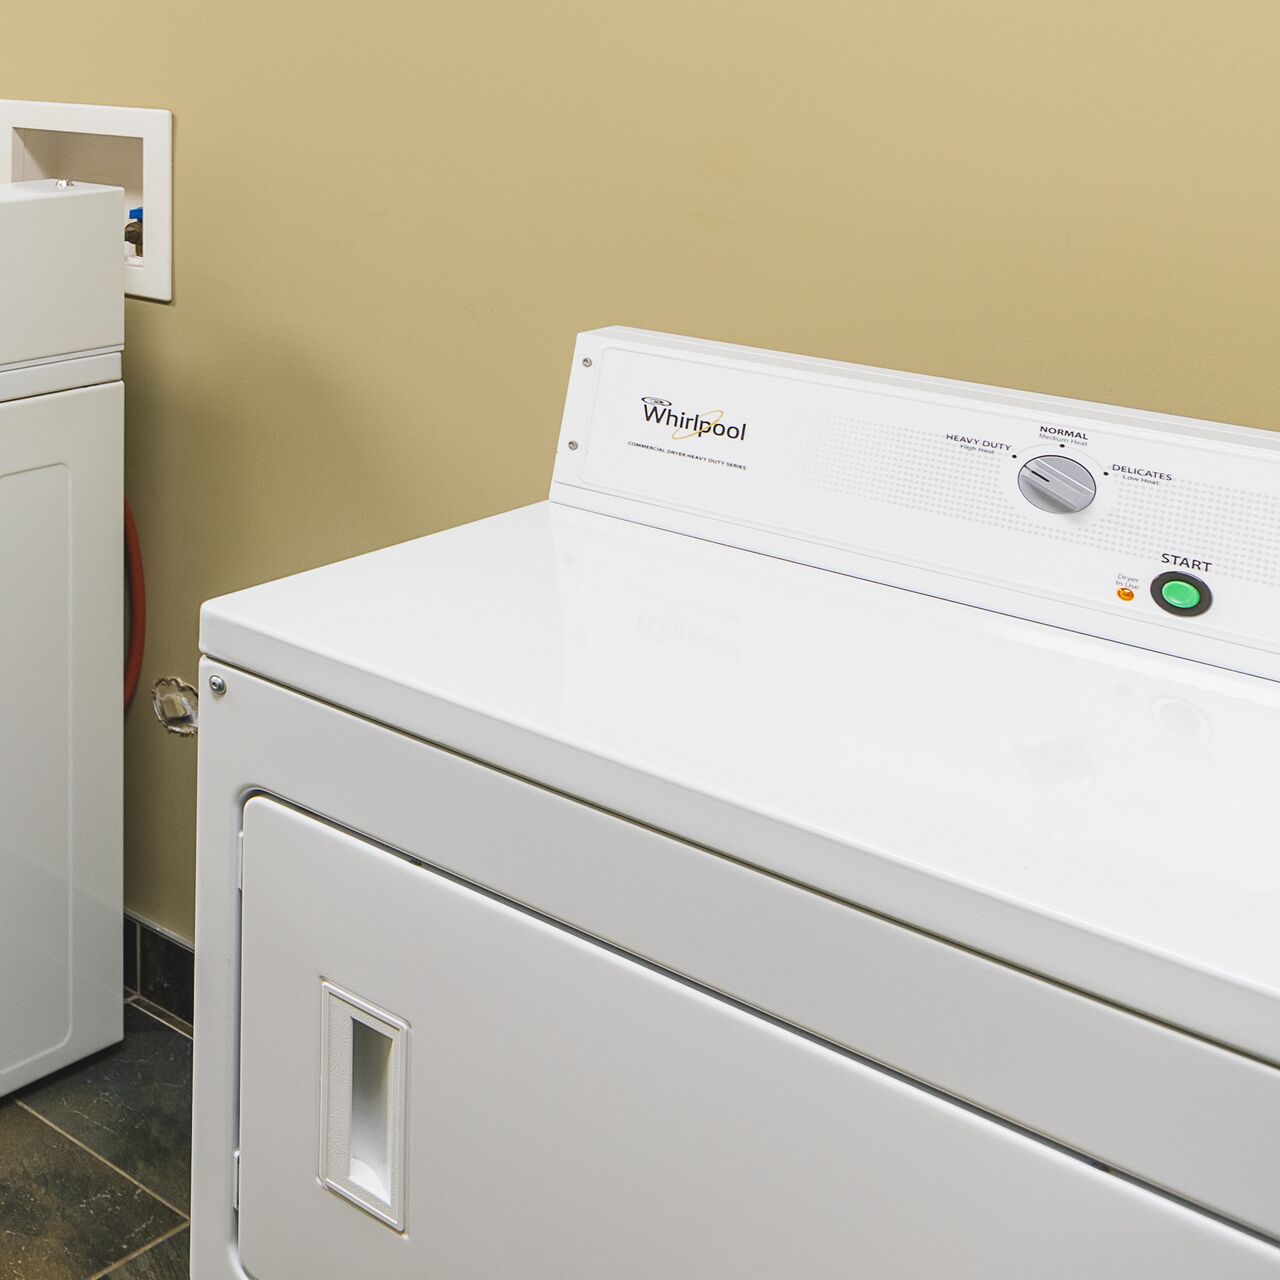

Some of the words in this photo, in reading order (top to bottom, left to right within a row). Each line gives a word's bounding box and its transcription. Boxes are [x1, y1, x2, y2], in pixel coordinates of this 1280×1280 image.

[643, 403, 747, 441] Whirlpool
[1038, 433, 1069, 443] Medium
[1070, 439, 1088, 447] Heat
[1039, 425, 1089, 441] NORMAL
[946, 433, 981, 446] HEAVY
[982, 440, 1012, 452] DUTY
[960, 444, 977, 452] High
[978, 446, 995, 454] Heat
[627, 440, 666, 454] COMMERCIAL
[666, 449, 686, 458] DRYER
[687, 453, 707, 462] HEAVY
[708, 458, 725, 466] DUTY
[726, 461, 747, 471] SERIES
[1111, 463, 1173, 482] DELICATES
[1122, 474, 1143, 483] Low
[1143, 477, 1160, 486] Heat
[1161, 553, 1213, 572] START
[1117, 573, 1139, 583] Dryer
[1125, 582, 1139, 590] Use
